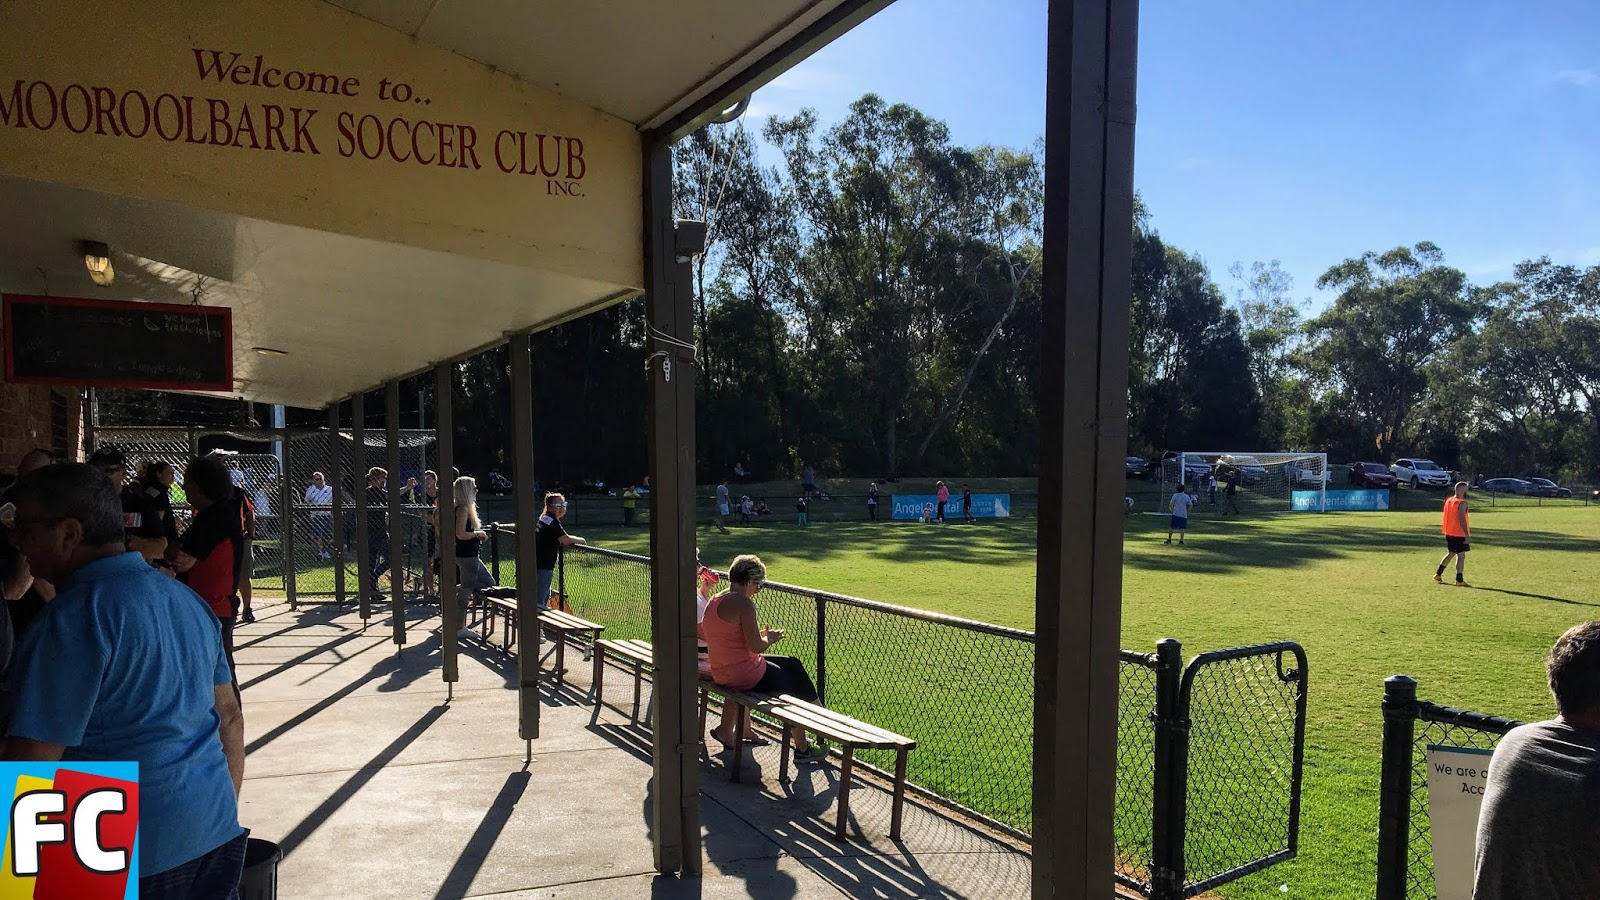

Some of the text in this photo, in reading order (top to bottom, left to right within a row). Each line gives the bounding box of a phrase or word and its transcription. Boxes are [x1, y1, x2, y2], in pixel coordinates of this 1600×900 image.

[192, 48, 360, 97] Welcome
[0, 80, 586, 180] MOOROOLBARK SOCCER CLUB
[546, 180, 585, 197] INC.
[894, 502, 924, 516] Angel
[925, 501, 960, 514] Detal
[1294, 496, 1317, 509] Angel
[1434, 763, 1452, 775] We
[1456, 767, 1477, 778] are
[1461, 782, 1486, 796] Acc
